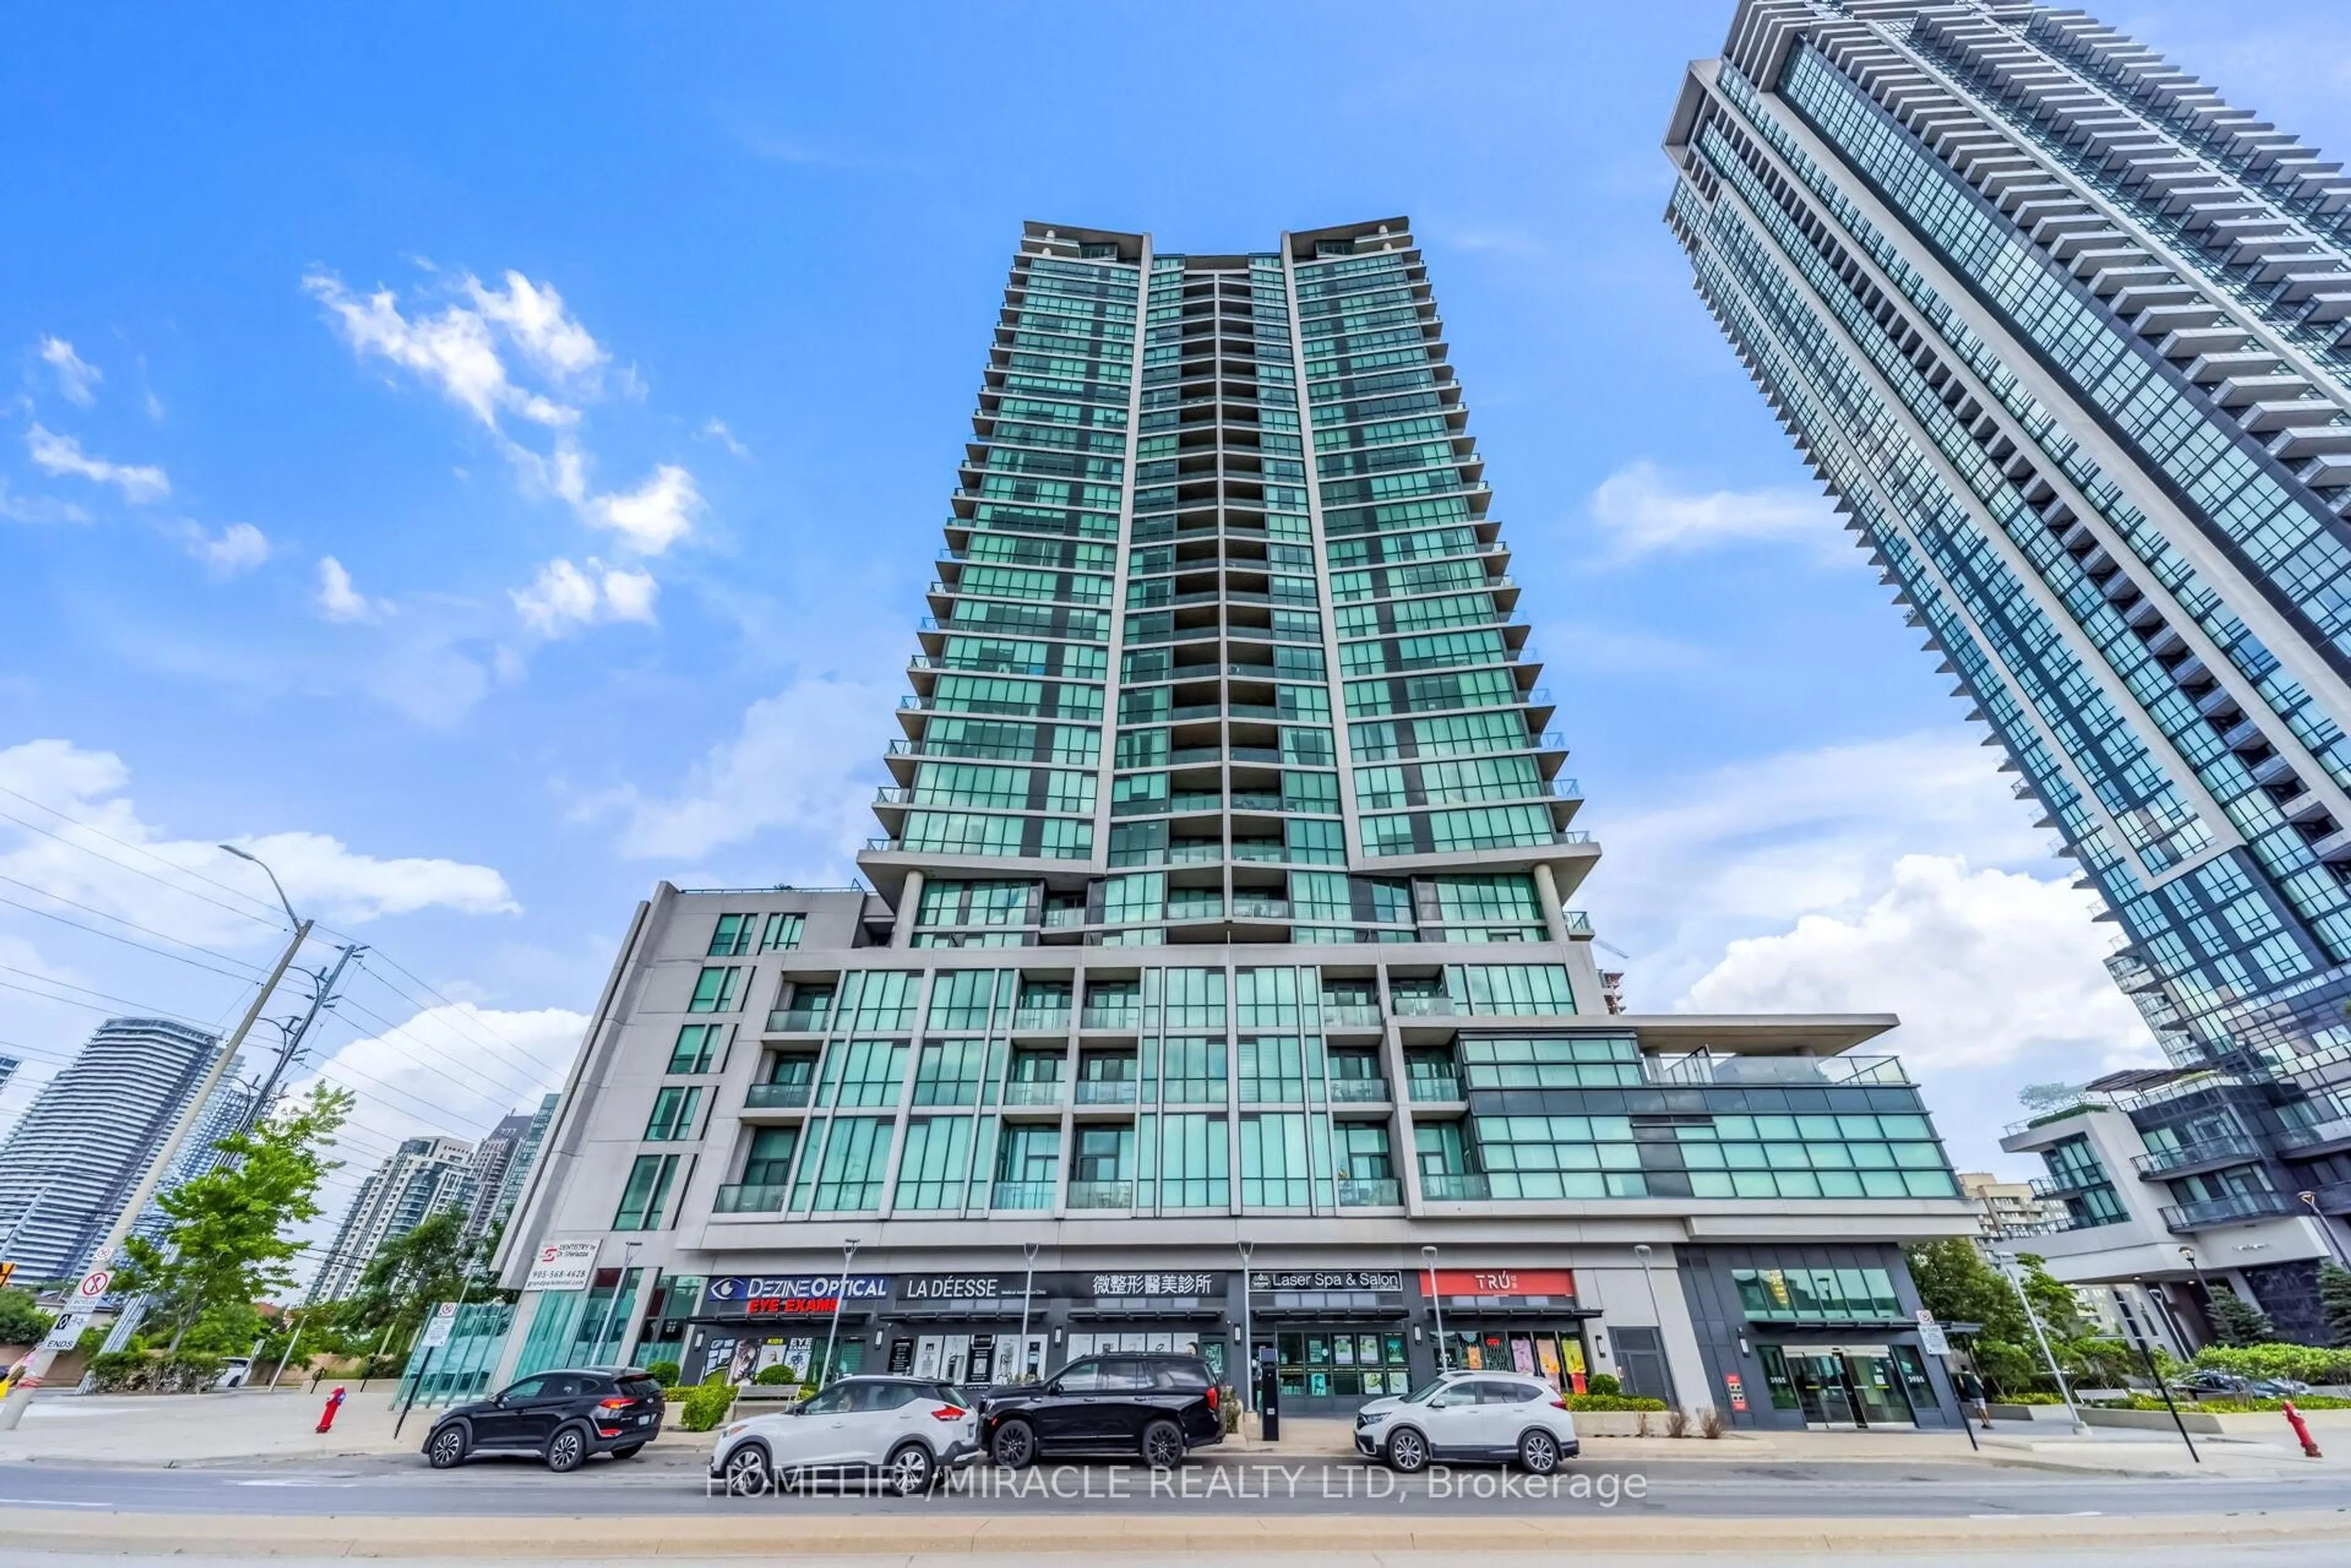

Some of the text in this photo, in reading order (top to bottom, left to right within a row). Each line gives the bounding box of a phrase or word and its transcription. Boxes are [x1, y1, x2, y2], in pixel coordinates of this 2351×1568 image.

[907, 1275, 999, 1297] LA DÉESSE
[1093, 1274, 1212, 1295] 微整形醫美診所
[1272, 1274, 1311, 1286] Laser
[1314, 1273, 1342, 1289] Spa
[1346, 1274, 1357, 1286] &
[1360, 1273, 1399, 1286] Salon
[748, 1299, 781, 1314] EYE
[790, 1337, 814, 1346] EYE
